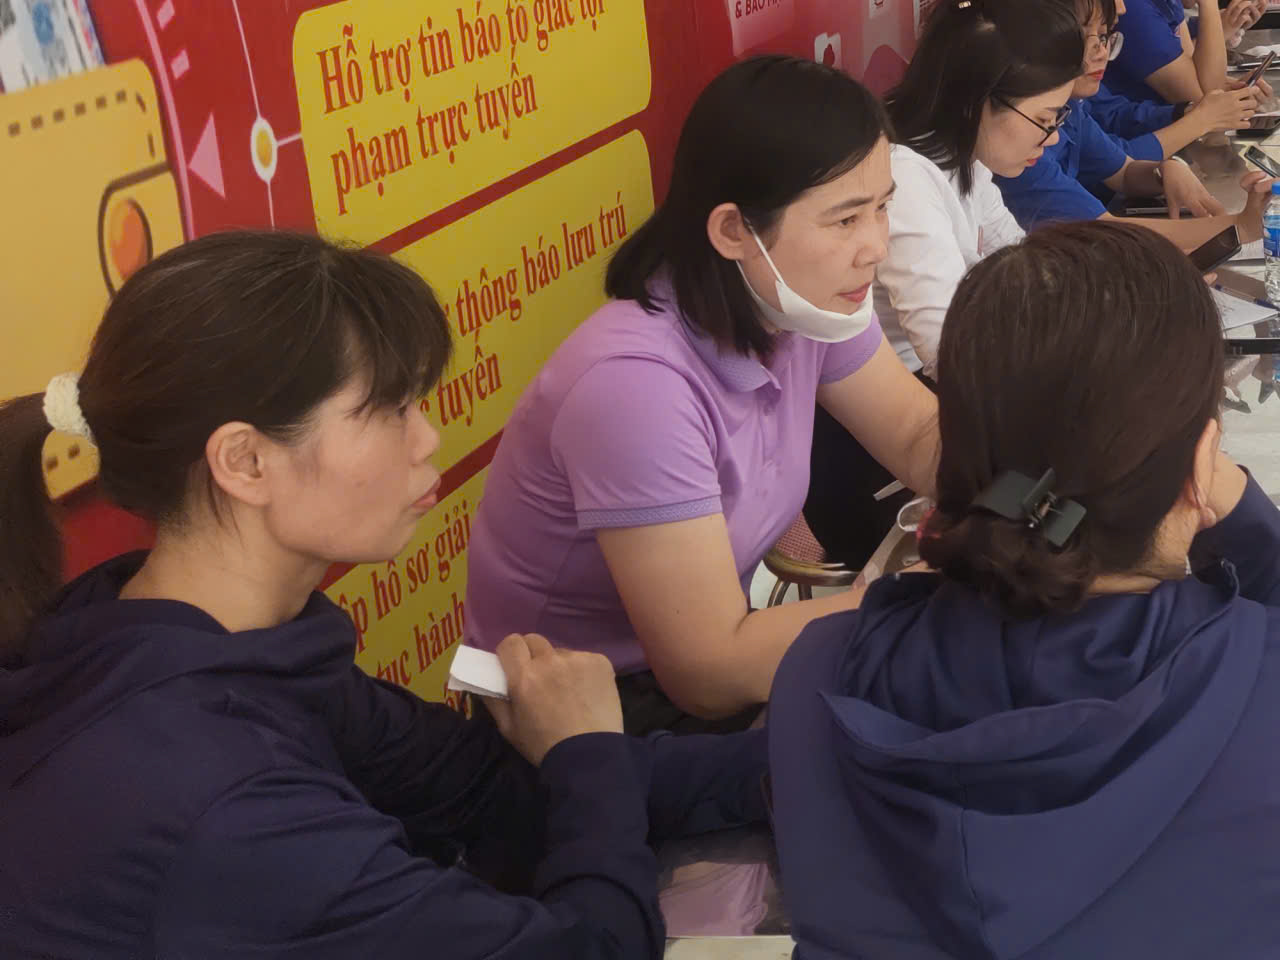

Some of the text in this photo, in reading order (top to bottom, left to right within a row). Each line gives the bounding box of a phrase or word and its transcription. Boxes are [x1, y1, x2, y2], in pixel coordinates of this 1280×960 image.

[317, 23, 363, 115] Hỗ
[370, 37, 412, 103] trợ
[418, 16, 456, 78] tin
[457, 0, 501, 64] báo
[735, 0, 742, 19] &
[330, 46, 539, 216] phạm trực tuyến
[456, 191, 628, 337] thông báo lưu trú
[437, 330, 503, 427] tuyến
[406, 543, 430, 594] sơ
[435, 500, 471, 583] giải
[414, 591, 466, 674] hành
